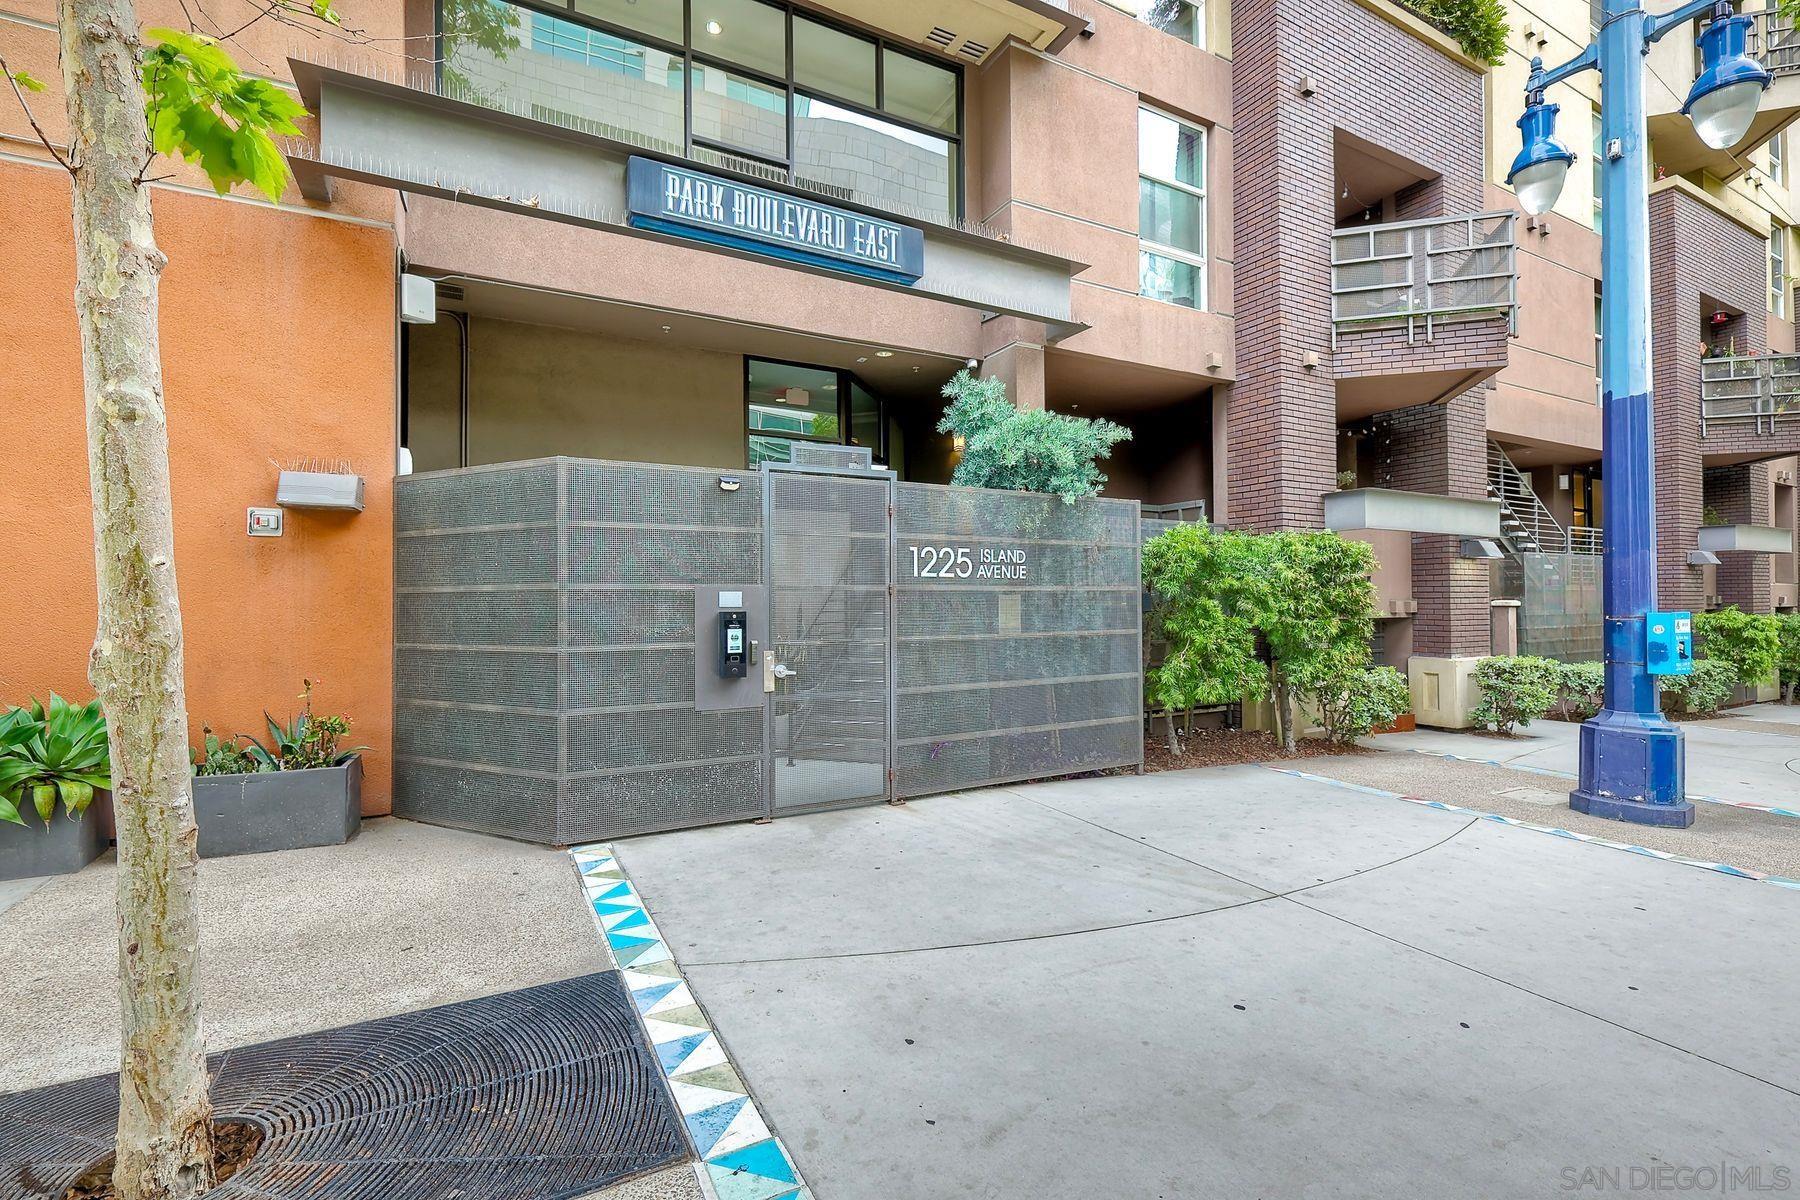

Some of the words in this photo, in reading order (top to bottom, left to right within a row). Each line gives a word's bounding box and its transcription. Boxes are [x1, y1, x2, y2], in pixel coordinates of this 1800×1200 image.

[665, 172, 724, 223] PARK
[732, 190, 845, 250] BOULEVARD
[853, 219, 900, 263] EAST
[909, 545, 973, 578] 1225
[979, 548, 1026, 563] ISLAND
[976, 564, 1027, 579] AVENUE
